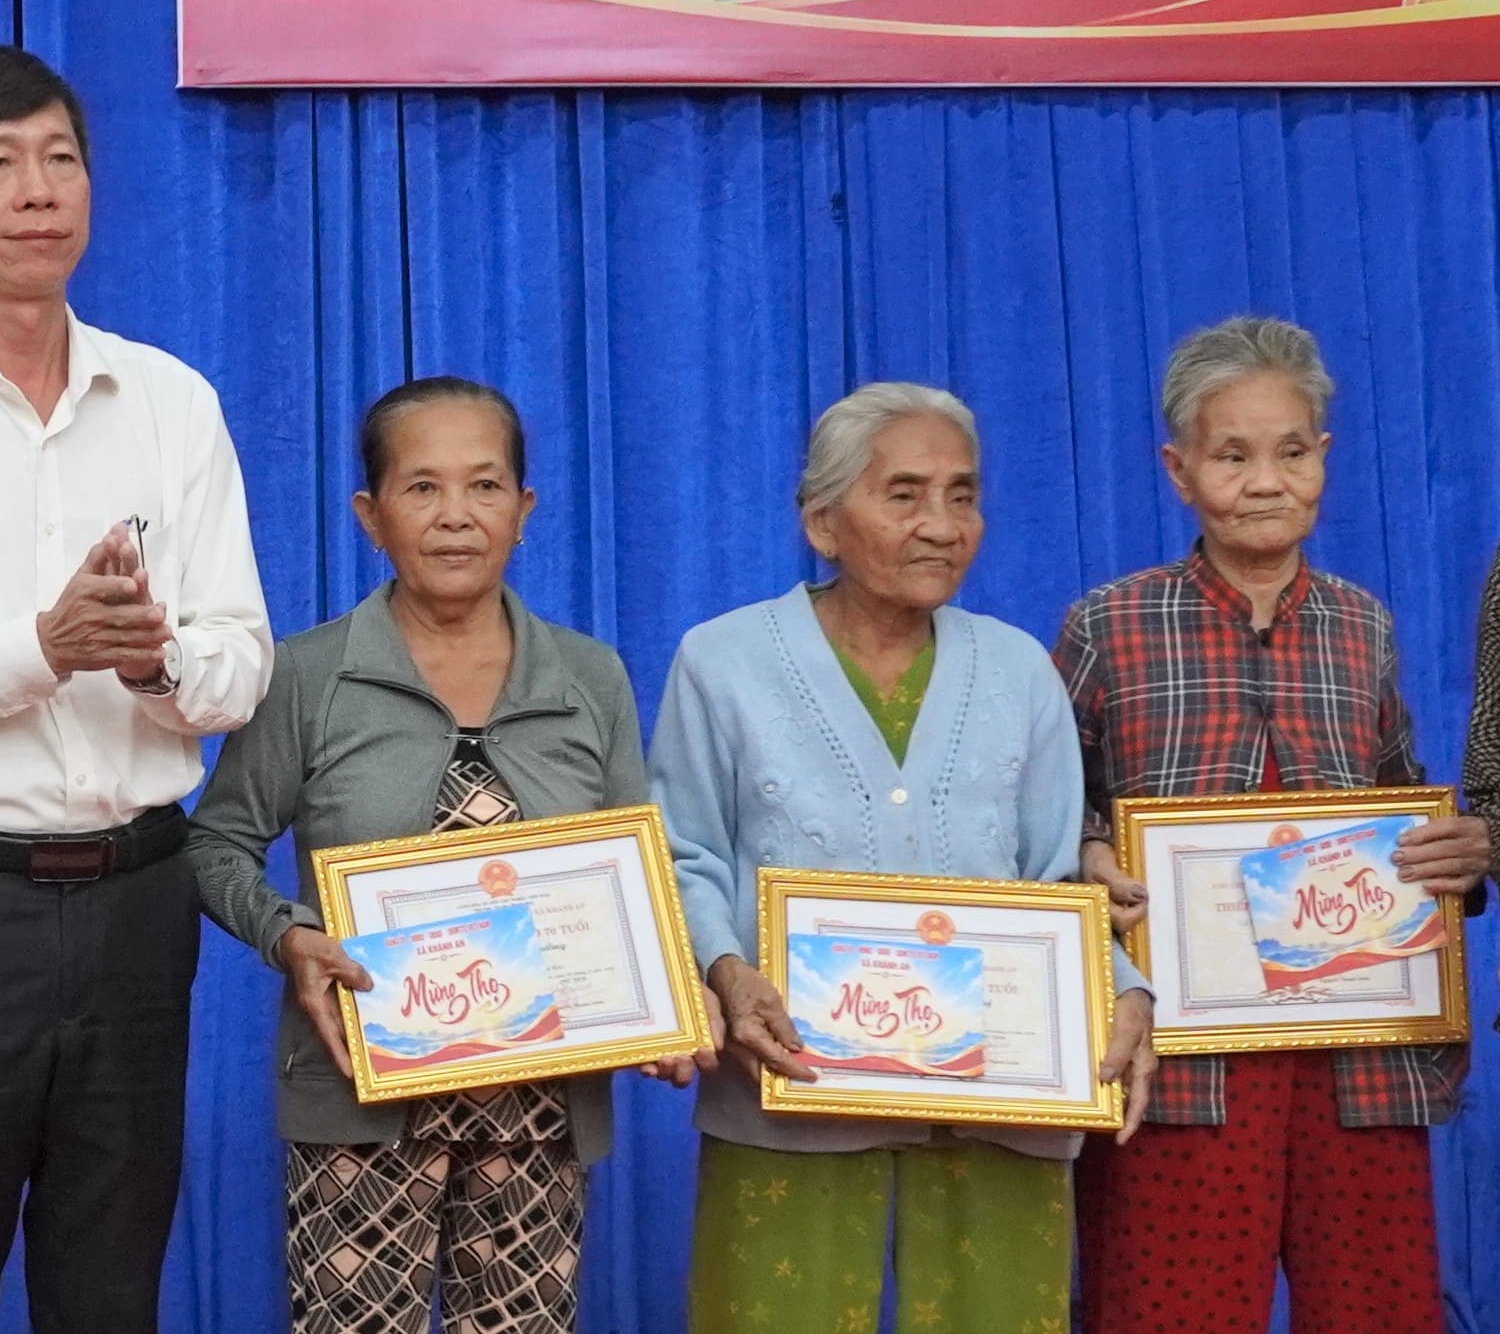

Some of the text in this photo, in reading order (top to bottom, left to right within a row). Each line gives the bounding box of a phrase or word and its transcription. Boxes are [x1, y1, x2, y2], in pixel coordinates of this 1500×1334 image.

[1292, 867, 1394, 935] Mừng Thọ
[399, 971, 471, 1026] Mừng
[456, 959, 511, 1012] Thọ
[831, 982, 943, 1038] Mừng Thọ
